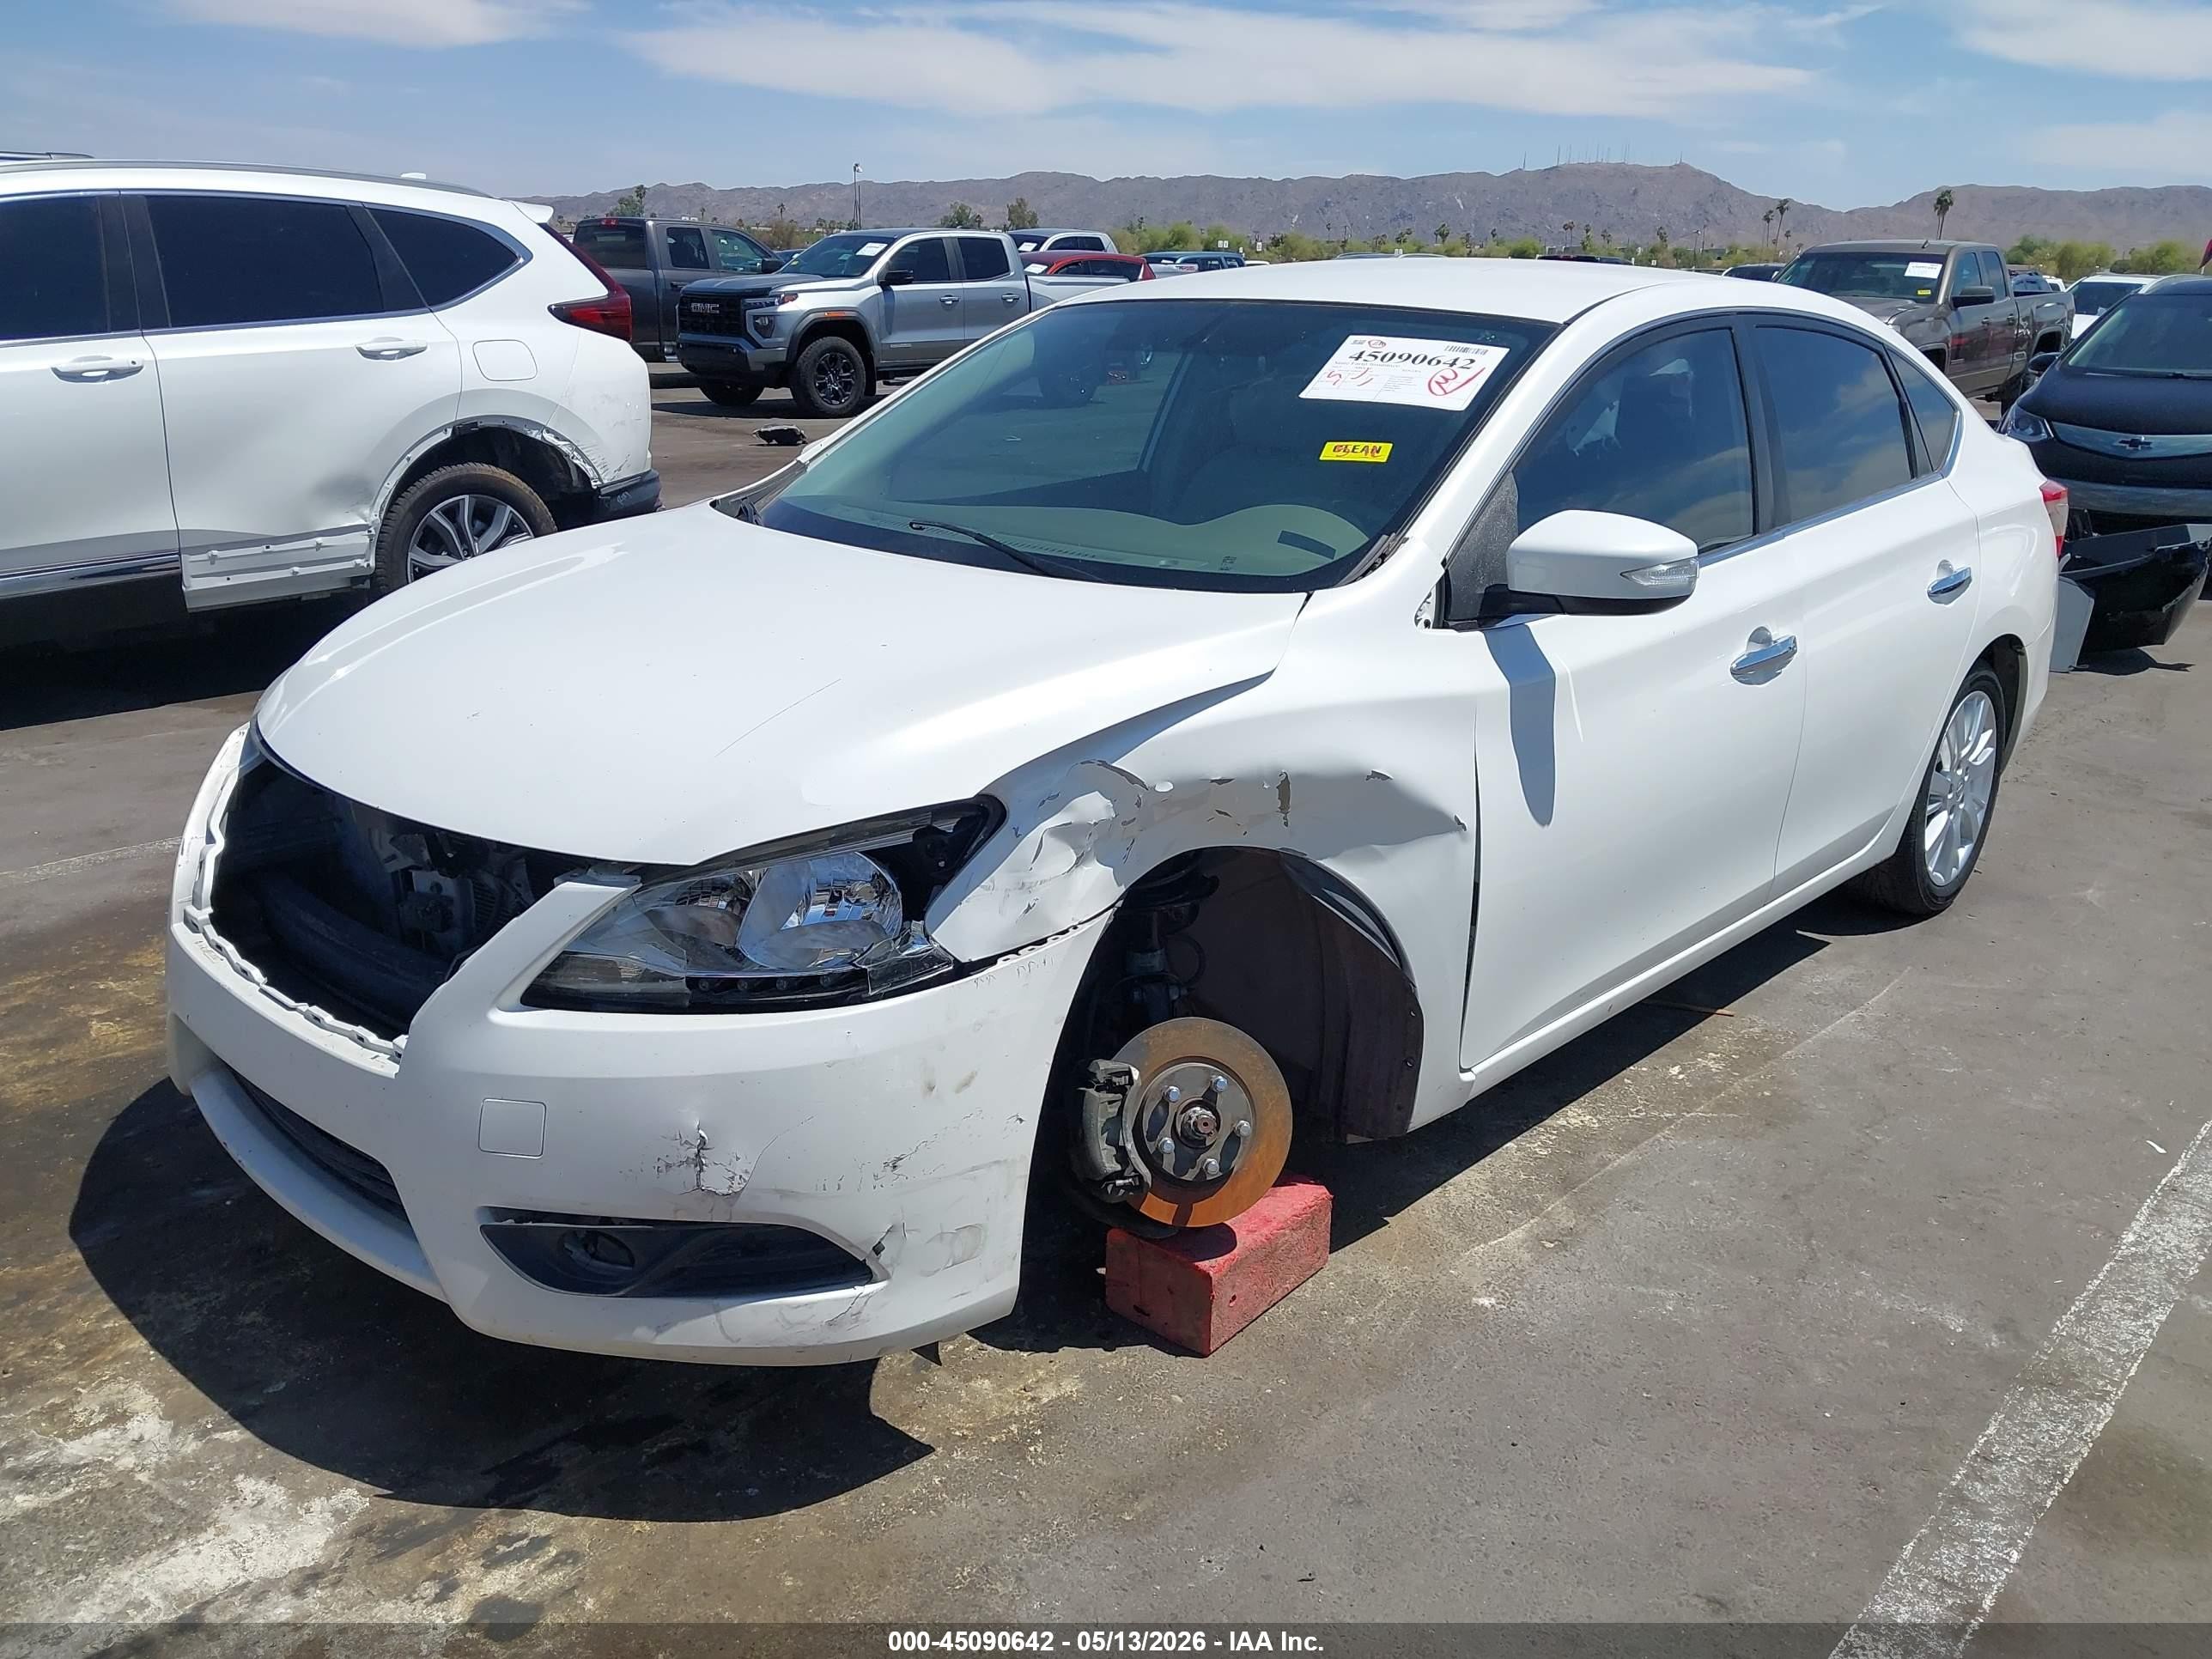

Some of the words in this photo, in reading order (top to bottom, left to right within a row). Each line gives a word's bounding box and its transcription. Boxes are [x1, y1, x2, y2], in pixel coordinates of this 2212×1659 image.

[691, 302, 719, 313] GMC
[1348, 349, 1476, 369] 45090642
[1332, 444, 1382, 454] CLEAN
